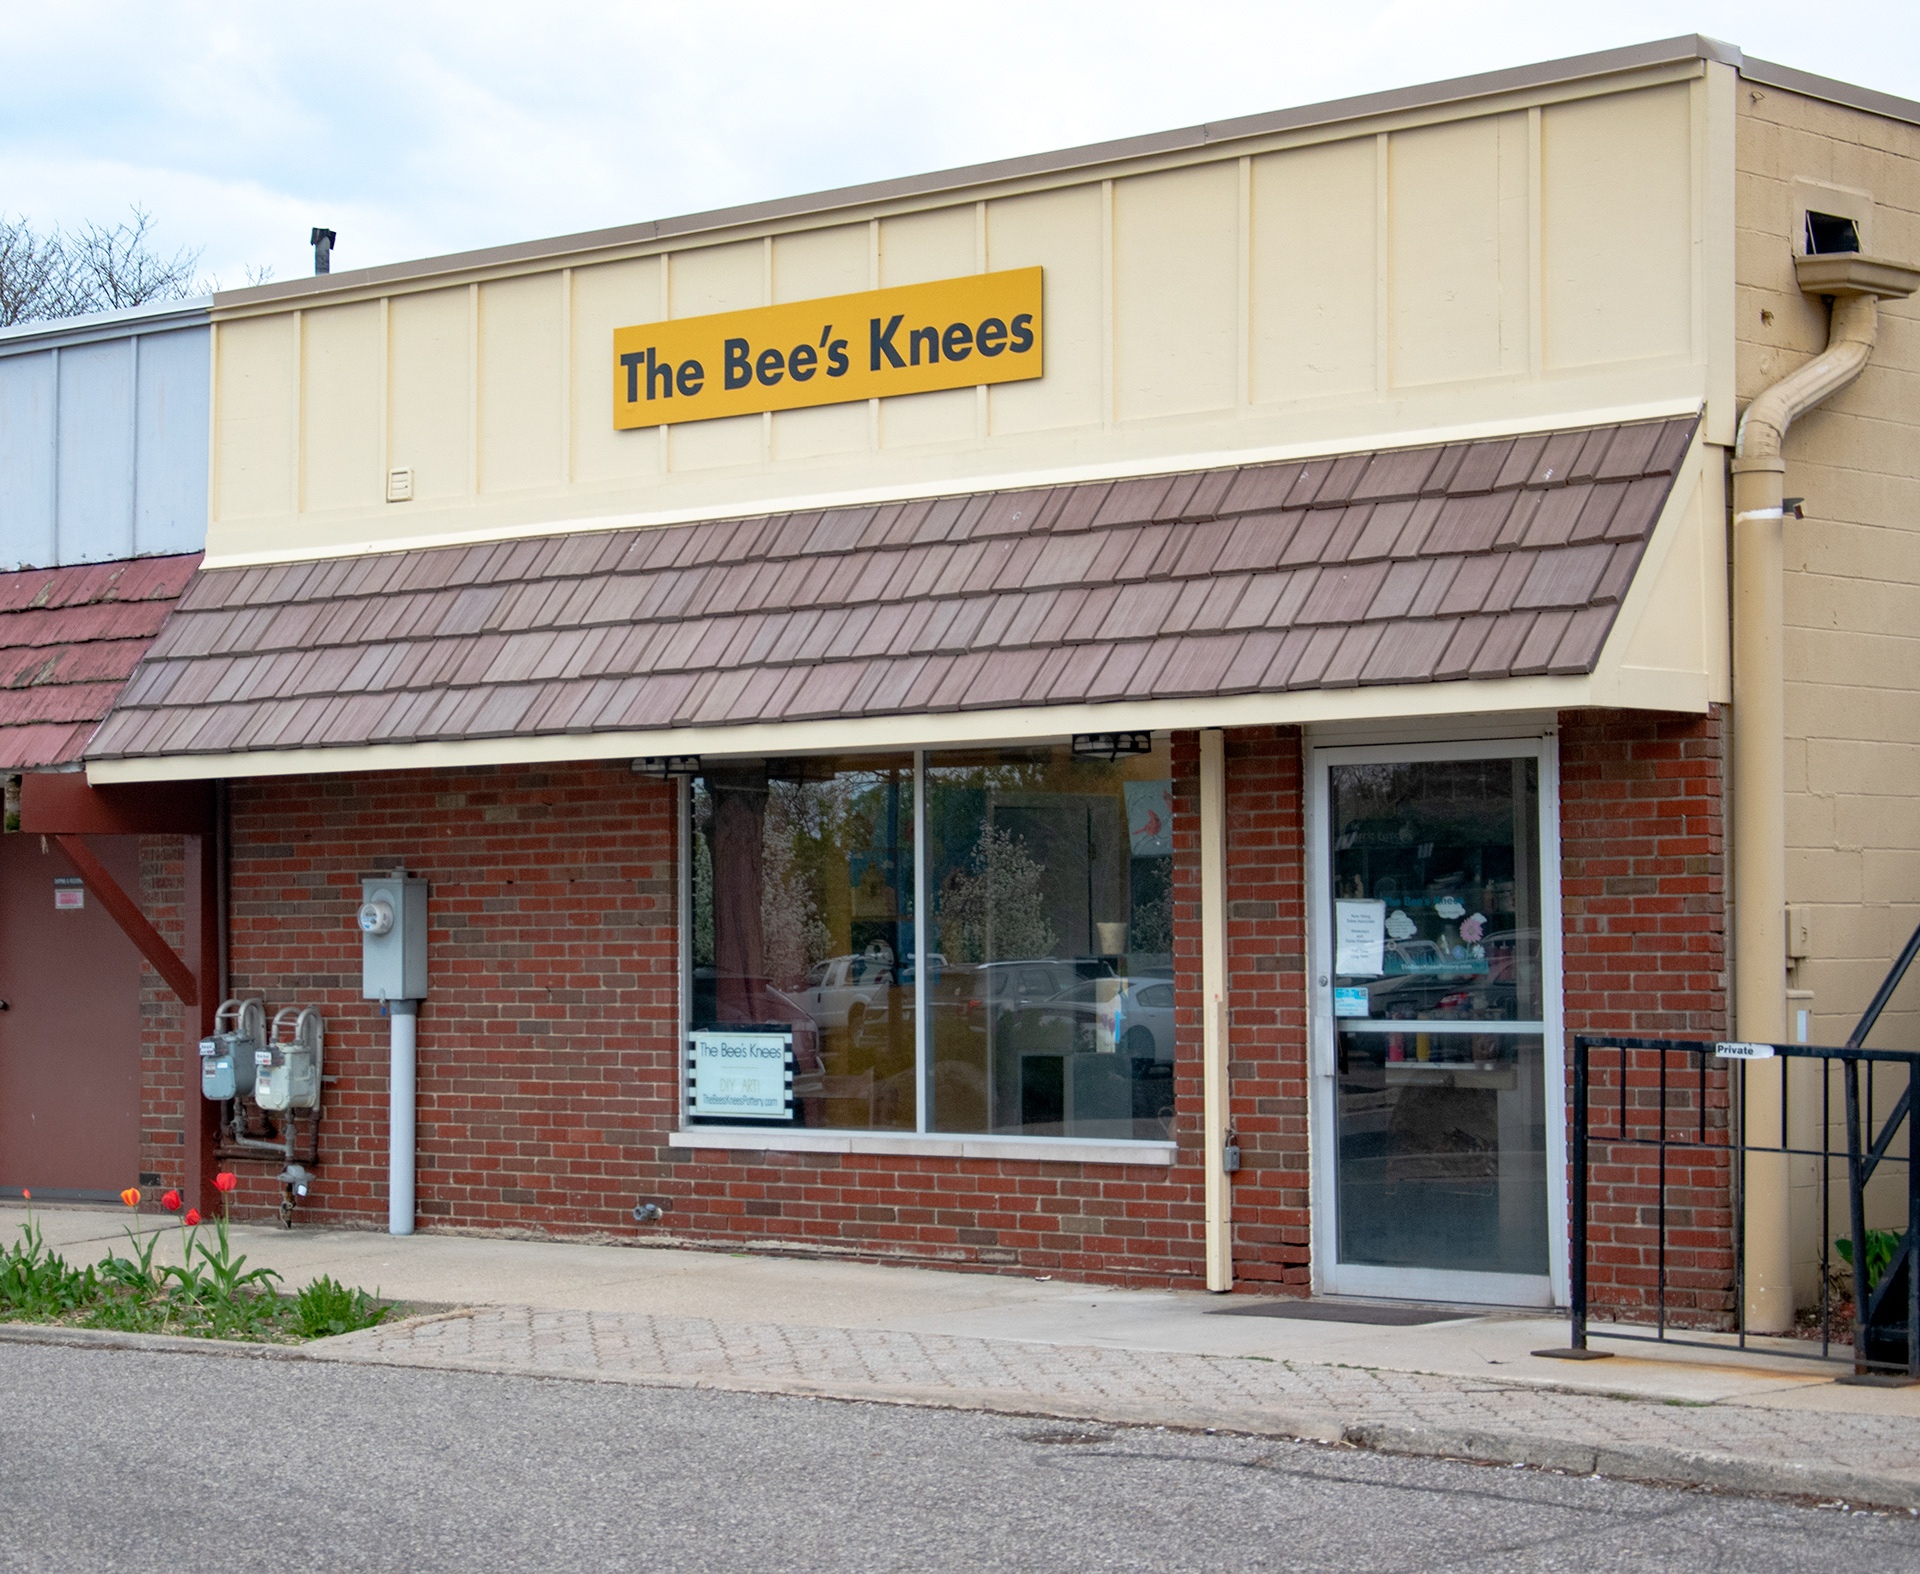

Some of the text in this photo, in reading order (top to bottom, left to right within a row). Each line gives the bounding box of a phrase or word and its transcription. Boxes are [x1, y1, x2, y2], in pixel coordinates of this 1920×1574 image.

[620, 313, 1034, 403] The Bee's Knees
[700, 1041, 782, 1058] The Bee's Knees
[1717, 1045, 1754, 1055] Private
